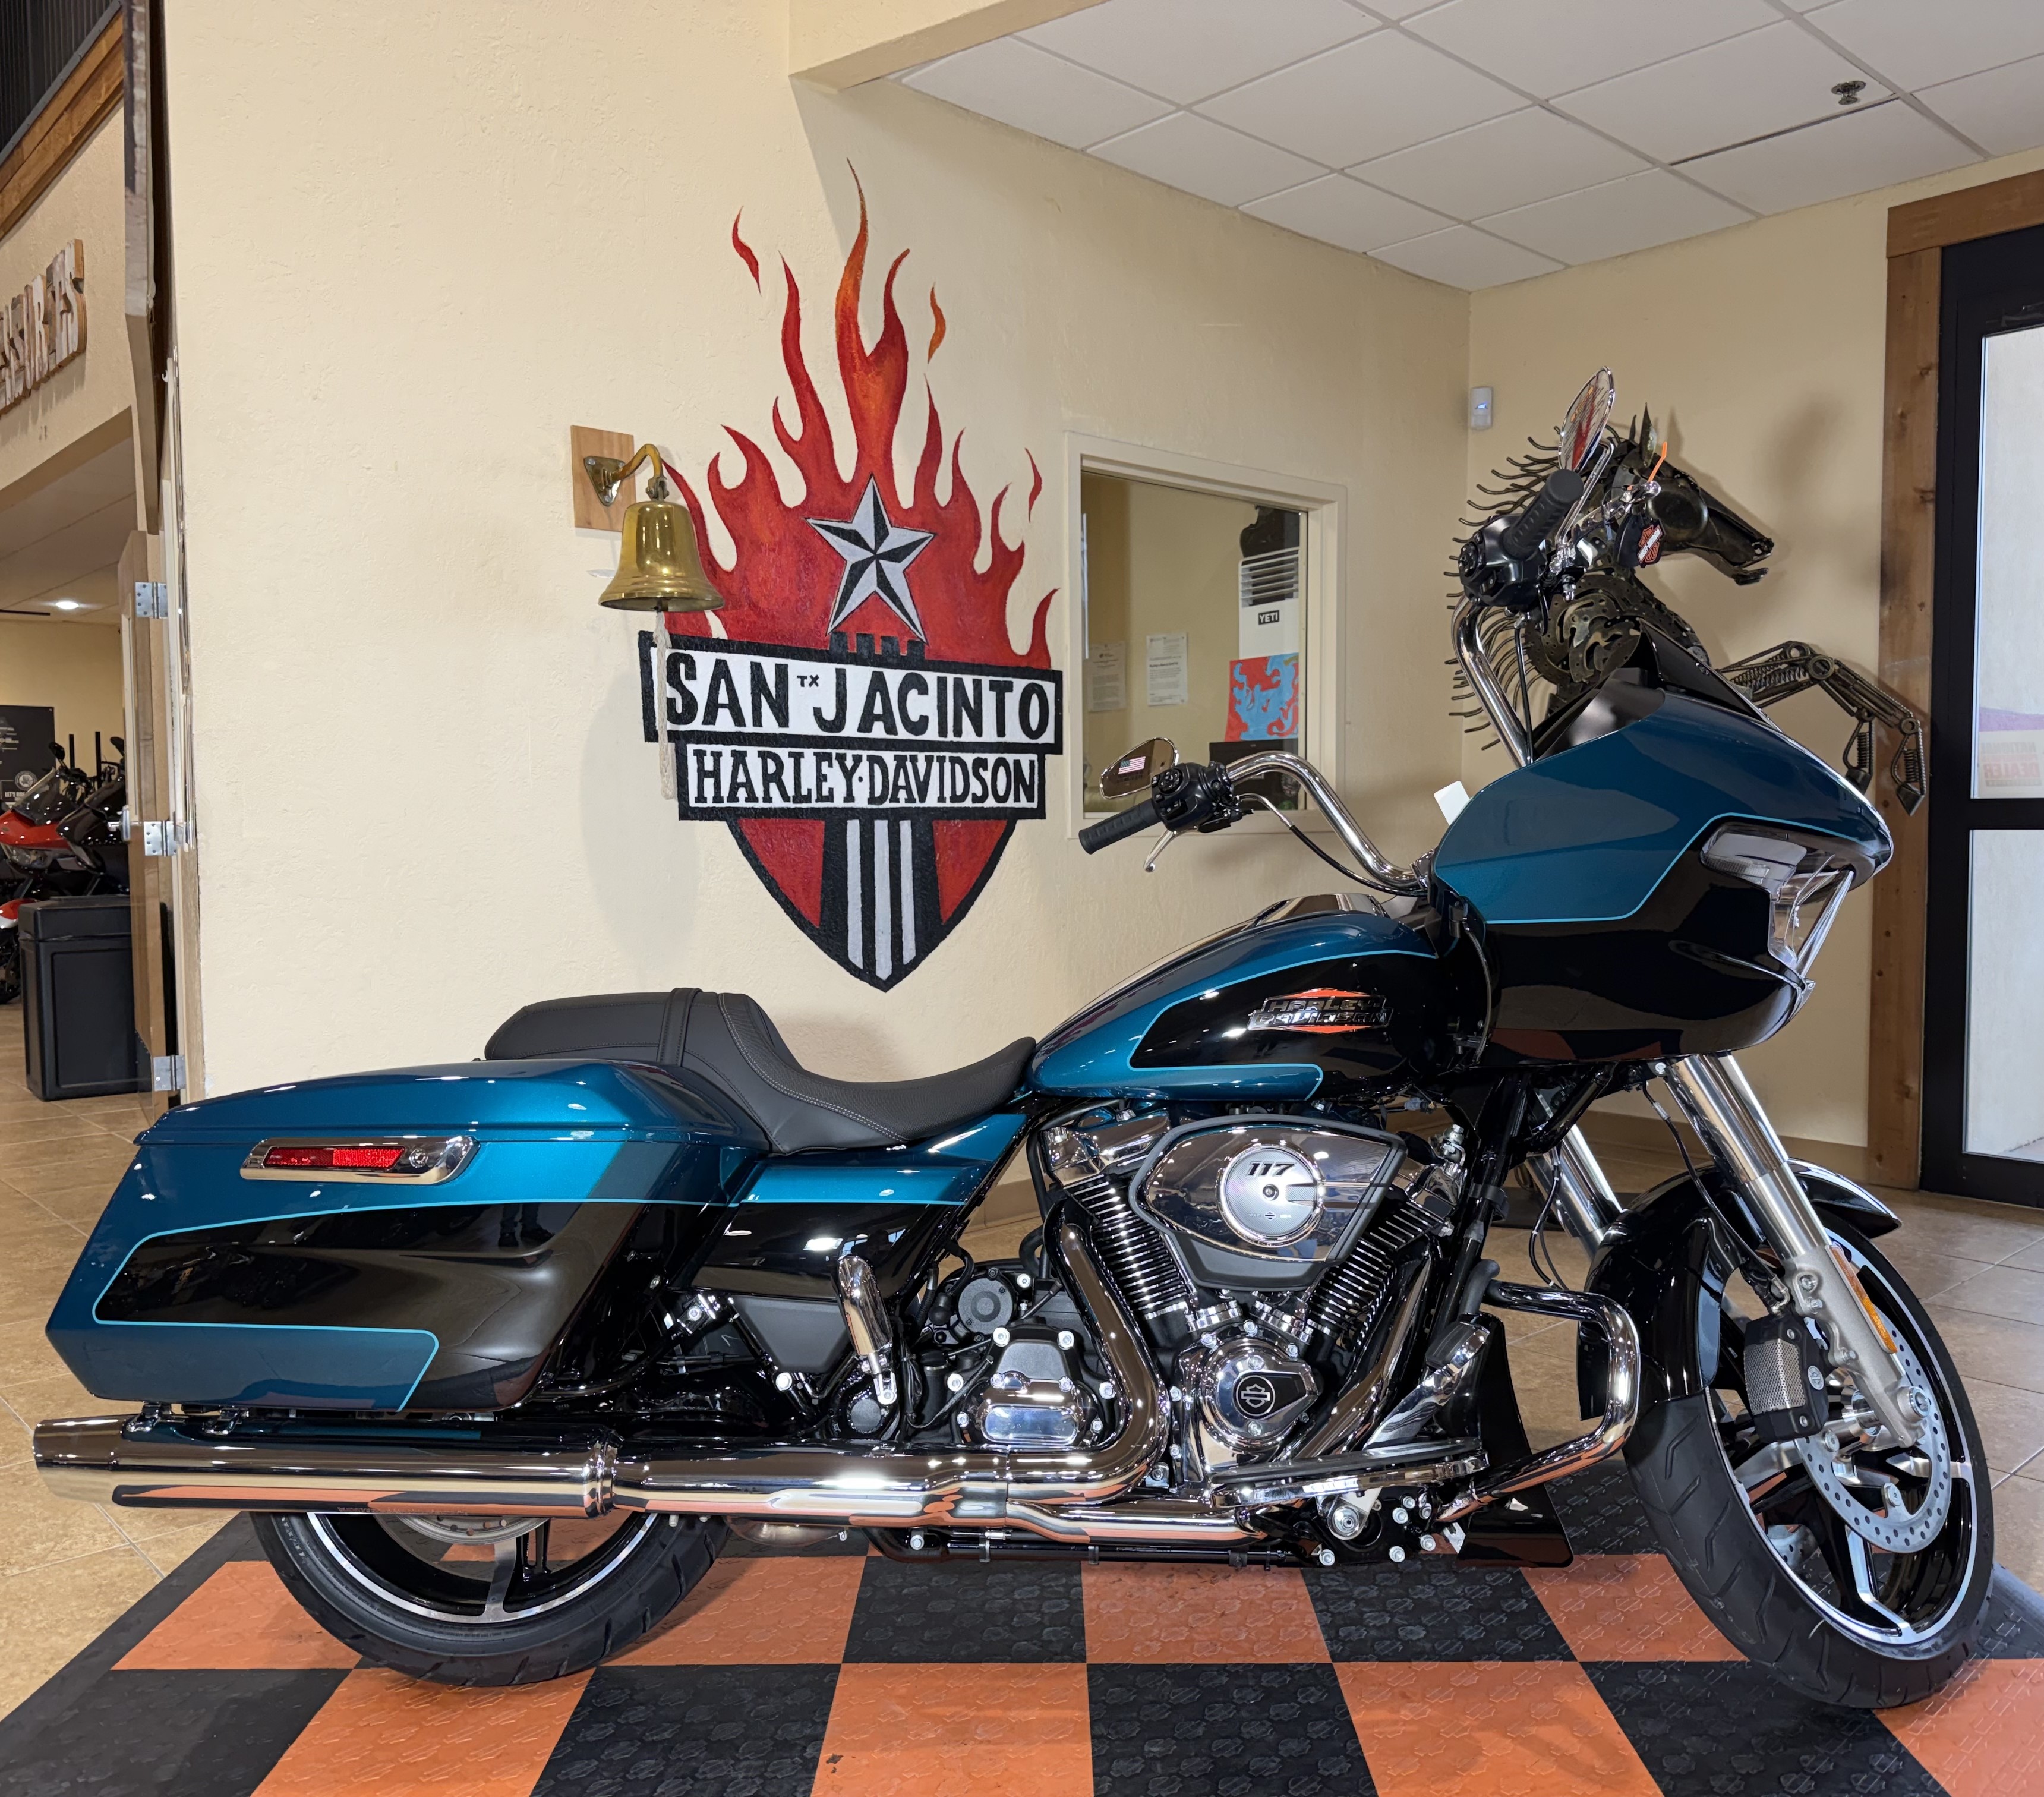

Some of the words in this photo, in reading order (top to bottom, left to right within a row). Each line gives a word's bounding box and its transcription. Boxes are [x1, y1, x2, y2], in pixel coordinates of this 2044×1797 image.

[1259, 612, 1279, 623] YETI
[667, 651, 790, 729] SAN
[797, 674, 819, 688] TX
[813, 667, 1049, 740] JACINTO
[1247, 1161, 1295, 1176] 117
